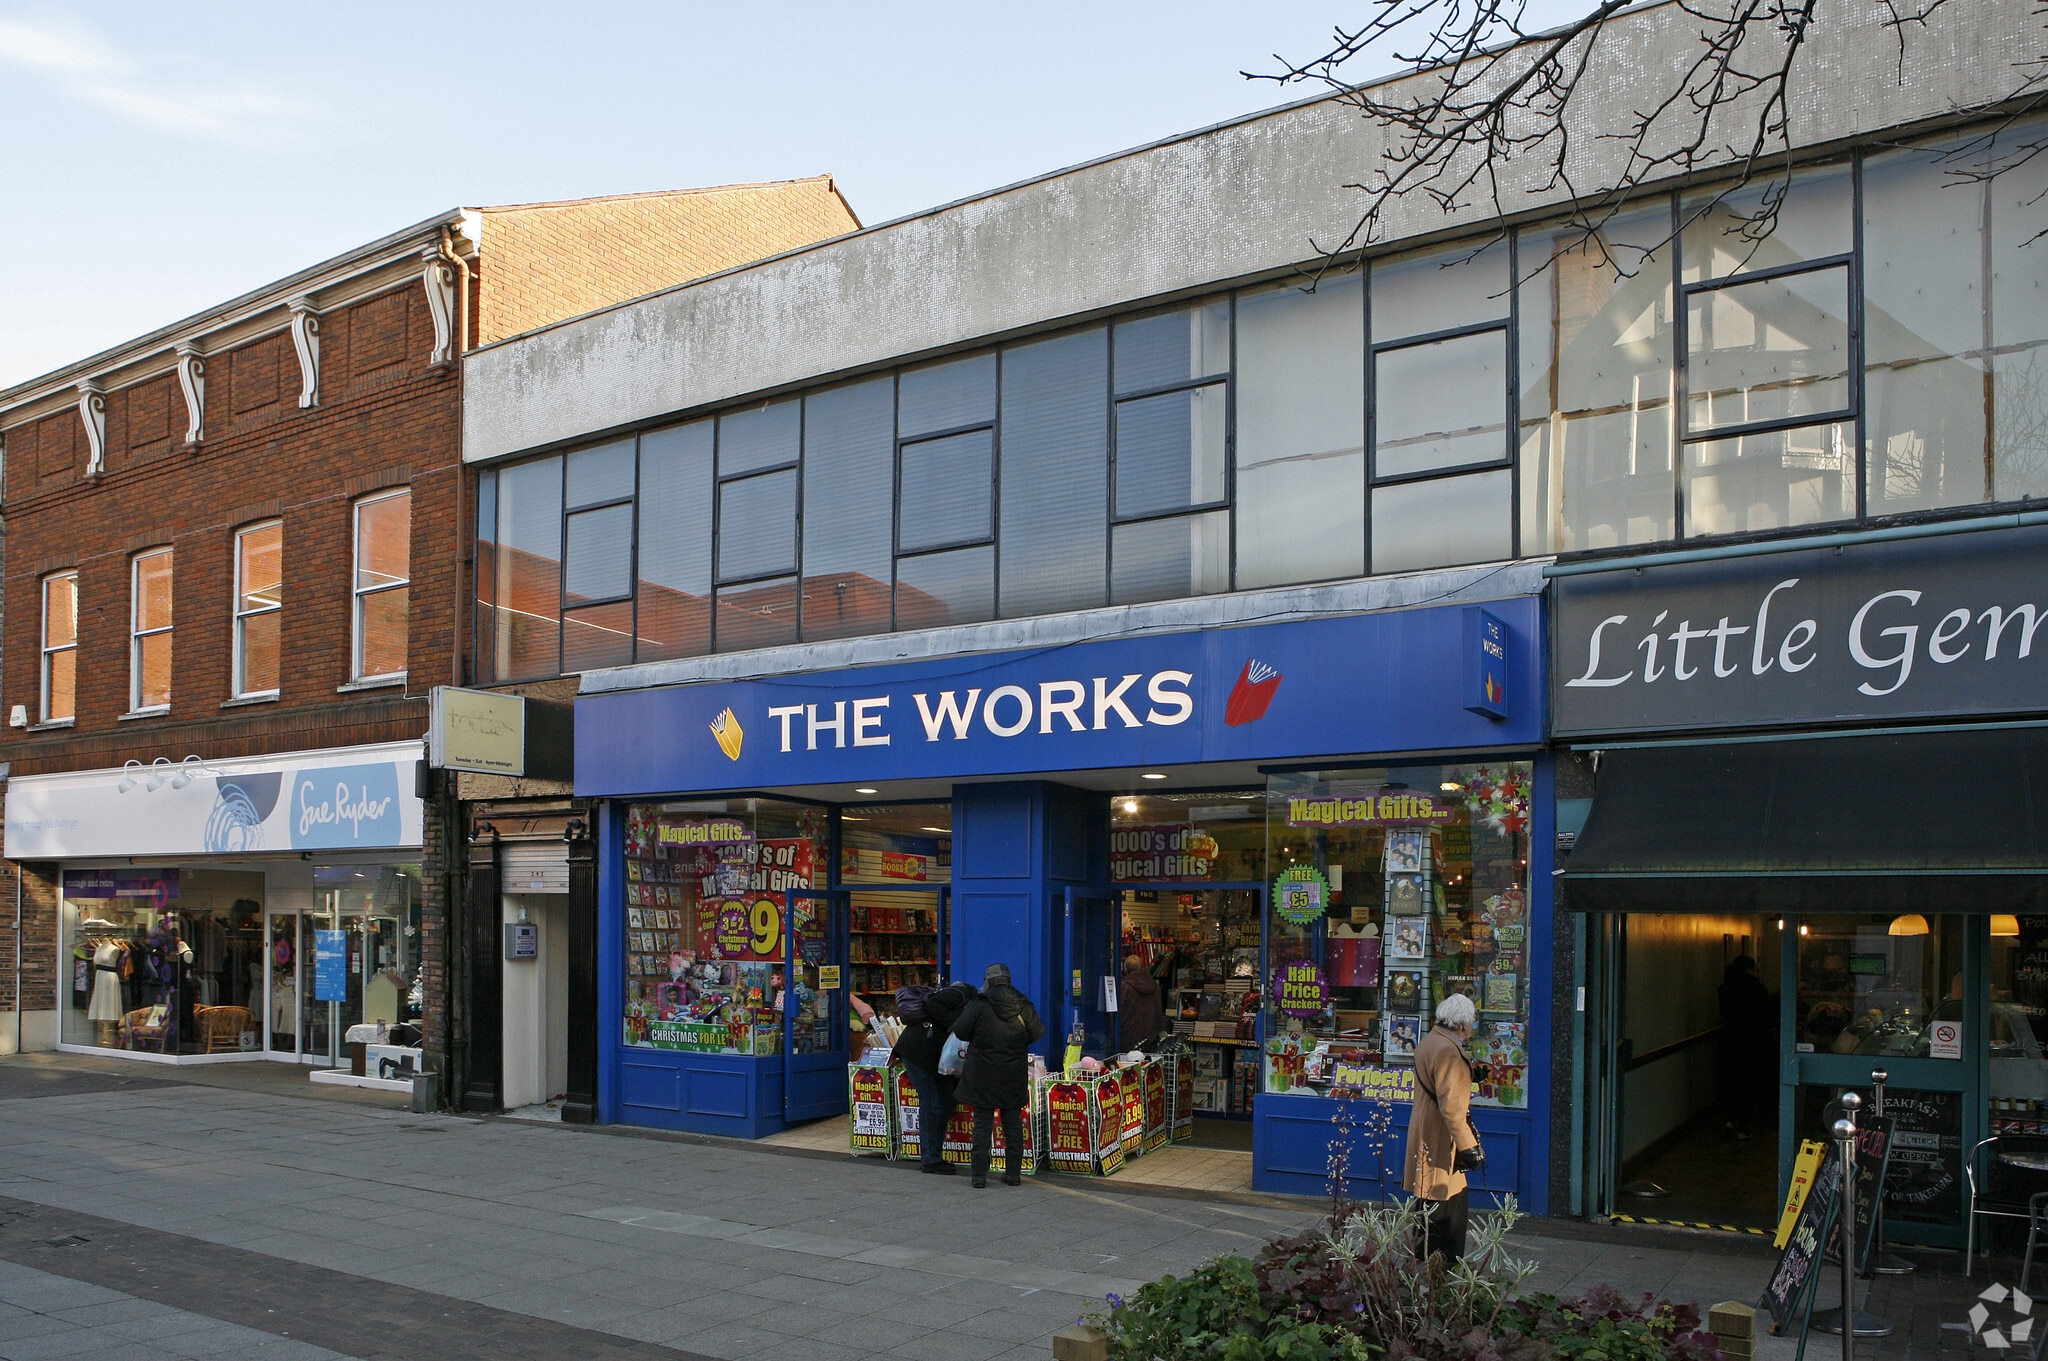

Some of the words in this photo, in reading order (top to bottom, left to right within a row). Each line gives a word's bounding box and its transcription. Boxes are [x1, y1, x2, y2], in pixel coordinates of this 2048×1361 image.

[1487, 622, 1499, 639] THE
[1564, 578, 1817, 687] Little
[1482, 638, 1504, 660] WORKS
[768, 696, 890, 752] THE
[913, 670, 1194, 741] WORKS
[299, 780, 335, 836] Sue
[335, 782, 391, 839] Ryder
[1290, 797, 1375, 824] Magical
[1378, 795, 1448, 820] Gifts...
[520, 819, 540, 832] 77
[659, 824, 709, 844] Magical
[1111, 831, 1166, 852] 1000's
[1169, 829, 1188, 851] of
[775, 844, 797, 867] of
[882, 862, 904, 873] BOOKS
[1164, 855, 1208, 876] Gifts
[769, 868, 809, 893] Gifts
[1289, 869, 1312, 881] FREE
[87, 879, 99, 887] and
[1290, 891, 1309, 907] £5
[722, 917, 730, 931] 3
[738, 917, 745, 931] 2
[718, 935, 748, 943] Christmas
[1495, 959, 1514, 971] 59p
[1287, 966, 1317, 982] Half
[1283, 982, 1320, 998] Price
[1281, 999, 1322, 1010] Crackers
[651, 1029, 698, 1044] CHRISTMAS
[700, 1032, 715, 1045] FOR
[717, 1034, 730, 1046] LE
[1334, 1065, 1400, 1086] Perfect
[855, 1082, 881, 1091] Magical
[1364, 1087, 1378, 1097] for
[1393, 1089, 1410, 1100] the
[1052, 1101, 1084, 1111] Magical
[1101, 1094, 1121, 1109] Magical
[1867, 1097, 1939, 1119] BEAKFAST
[853, 1127, 887, 1136] CHRISTMAS
[901, 1134, 920, 1143] CHRIS
[1101, 1129, 1116, 1144] FREE
[853, 1136, 867, 1146] FOR
[868, 1136, 887, 1147] LESS
[901, 1143, 918, 1155] FOR
[1057, 1135, 1083, 1149] FREE
[942, 1150, 959, 1162] FOR
[1050, 1151, 1090, 1161] CHRISTMAS
[1110, 1150, 1123, 1166] LESS
[1901, 1152, 1930, 1160] OPEN
[1051, 1160, 1069, 1171] FOR
[1069, 1161, 1092, 1172] LESS
[1906, 1172, 1955, 1203] TAKEAWAY
